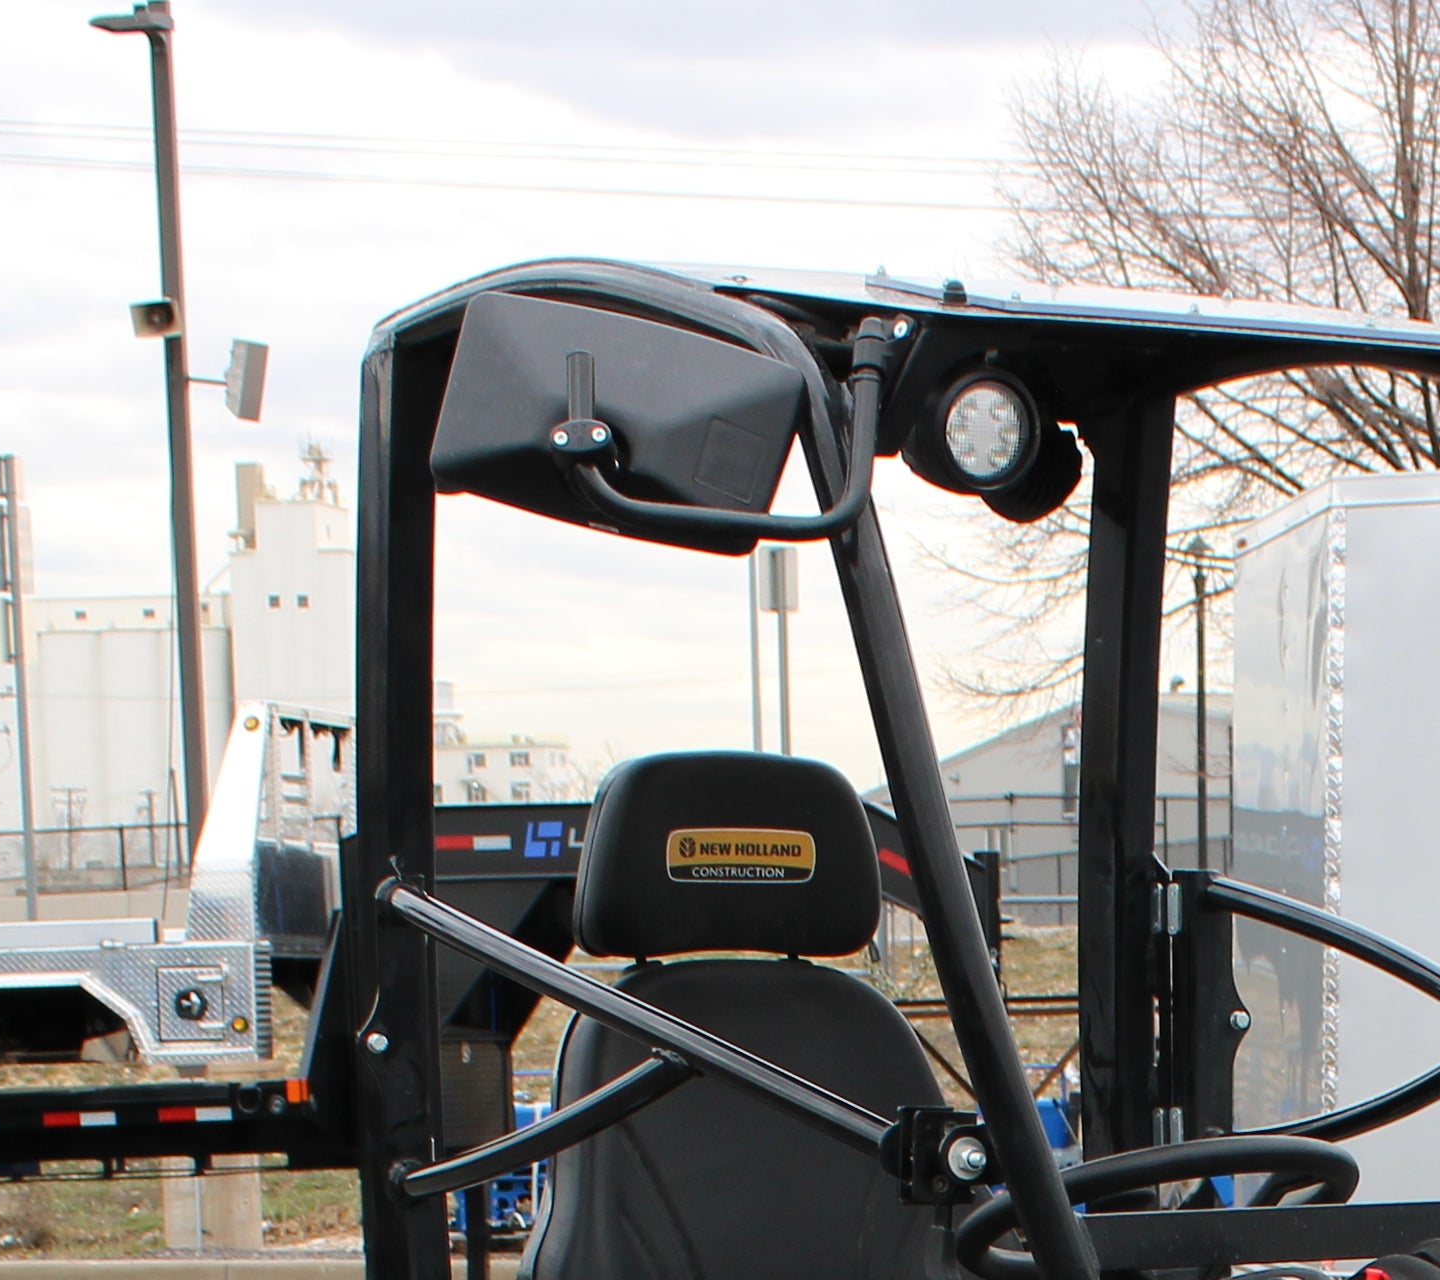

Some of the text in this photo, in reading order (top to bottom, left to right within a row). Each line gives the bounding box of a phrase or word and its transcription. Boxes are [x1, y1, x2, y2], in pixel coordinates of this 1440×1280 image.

[700, 843, 802, 857] NEW HOLLAND
[692, 866, 785, 878] CONSTRUCTION
